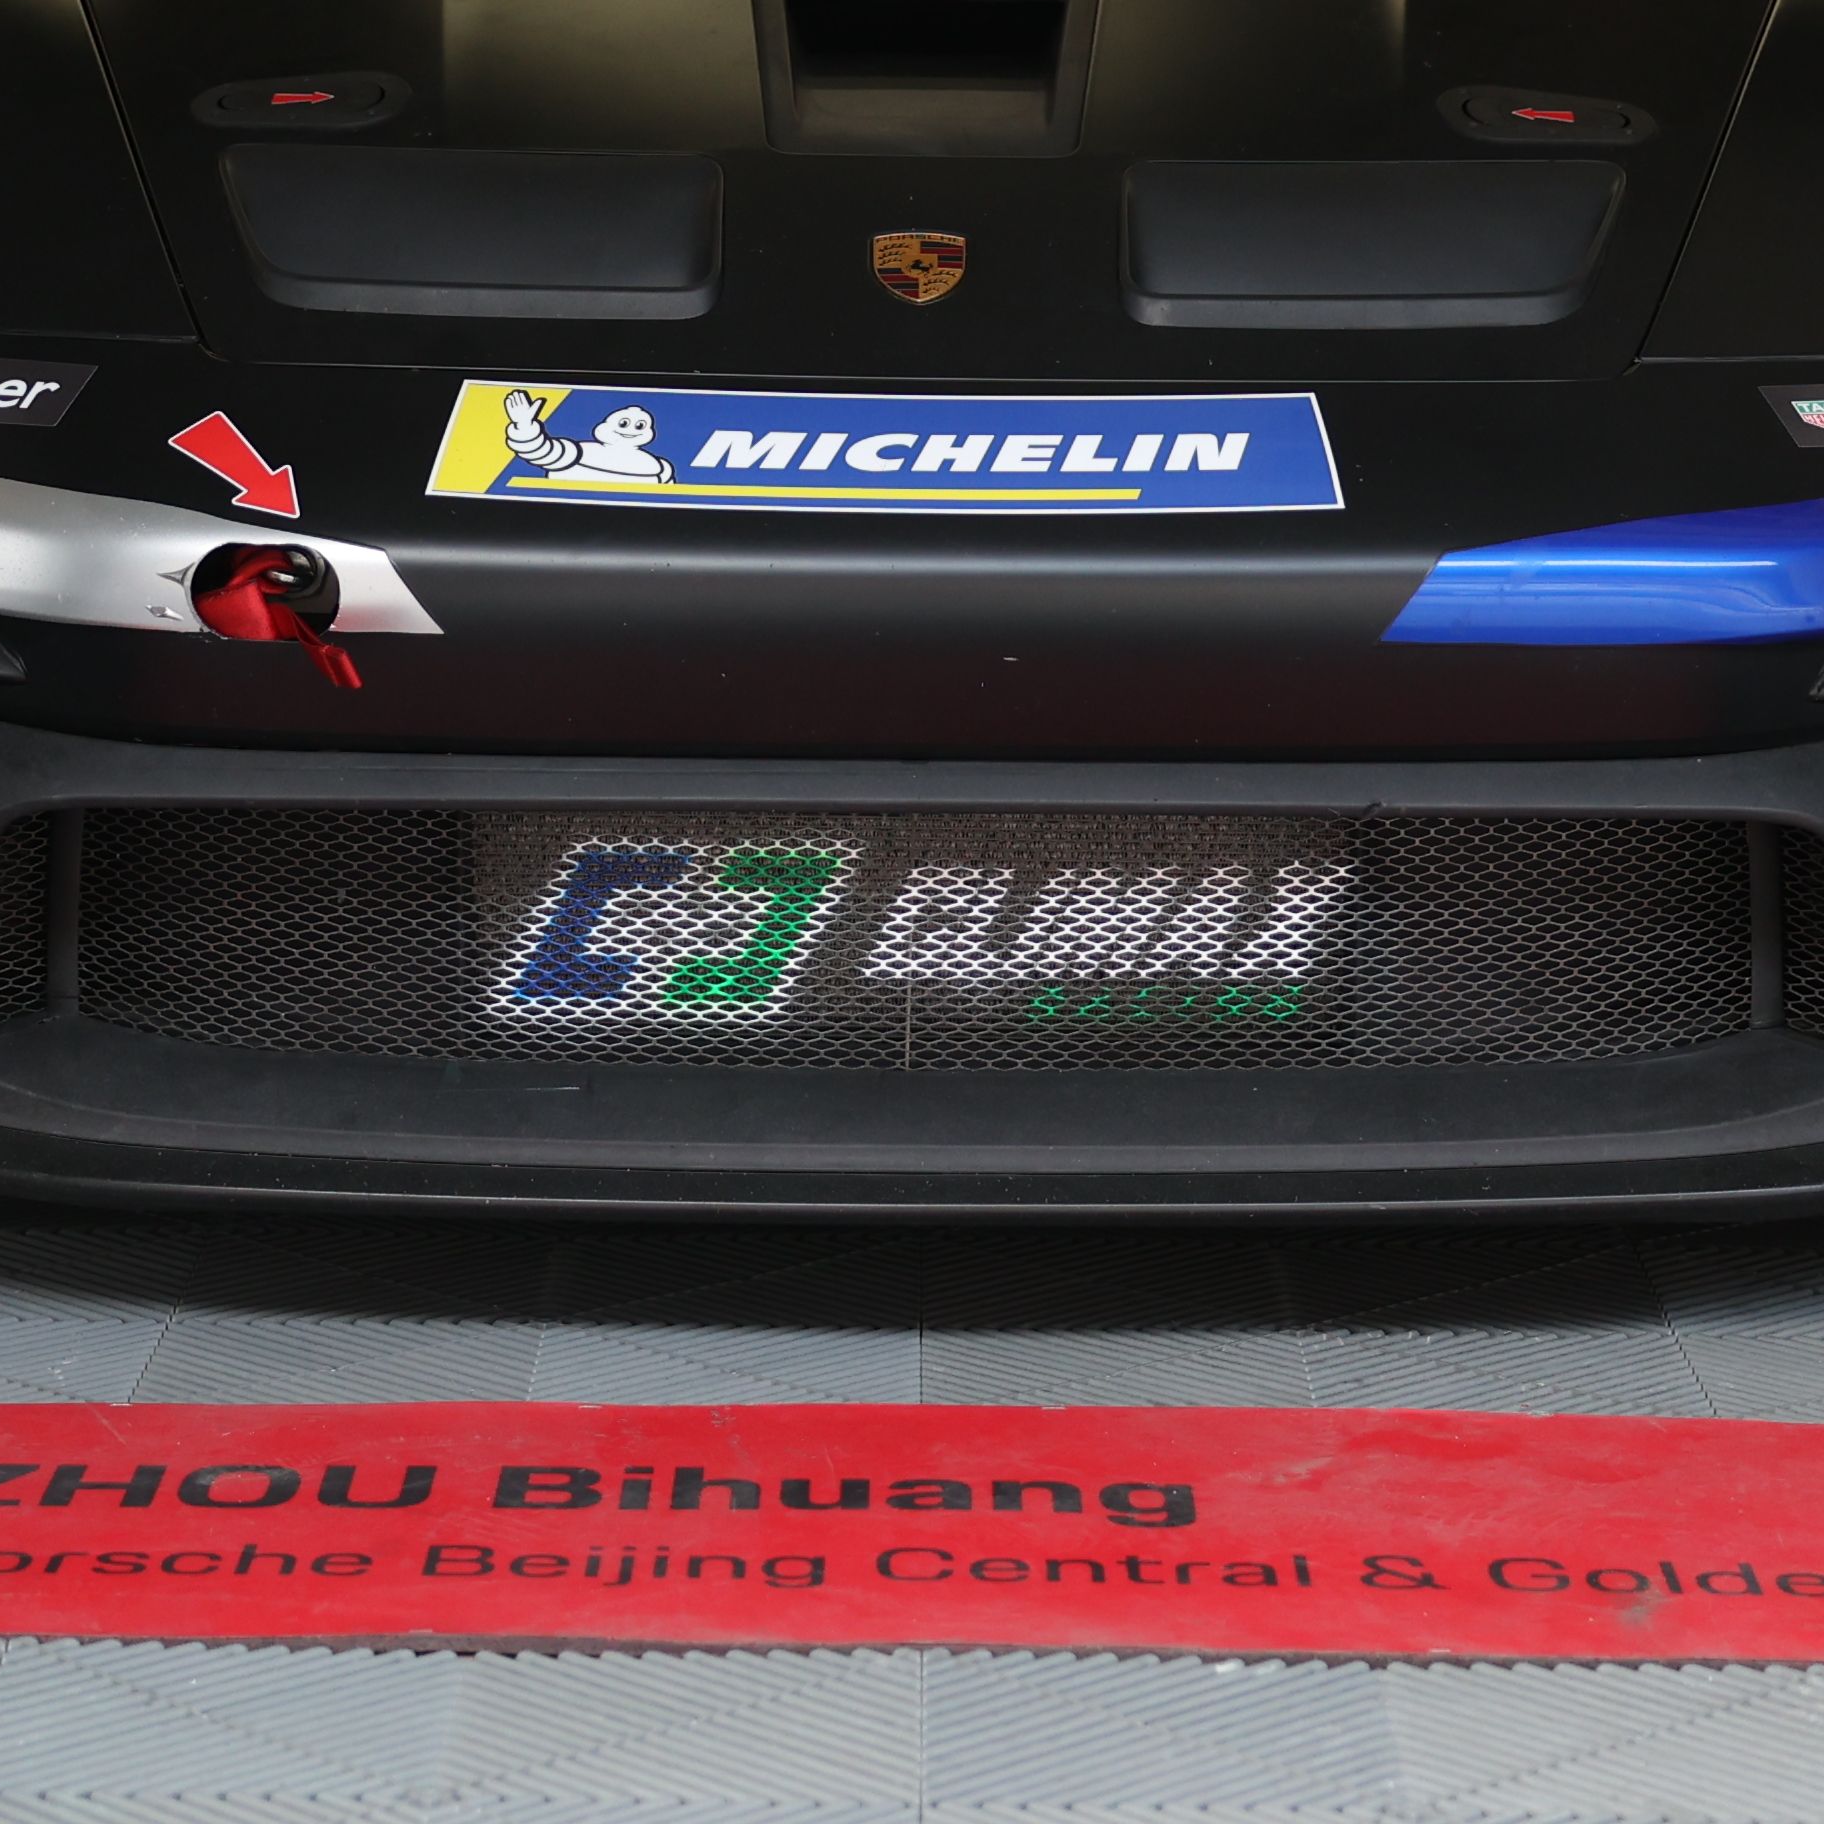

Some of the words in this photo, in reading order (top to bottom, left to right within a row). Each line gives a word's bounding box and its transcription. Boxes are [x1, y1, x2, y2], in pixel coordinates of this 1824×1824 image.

[689, 429, 1251, 474] MICHELIN
[860, 862, 1354, 980] CLIMAX
[490, 1465, 1197, 1529] Bihuang
[421, 1544, 827, 1589] Beijing
[875, 1546, 1313, 1589] Central
[1360, 1555, 1452, 1592] &
